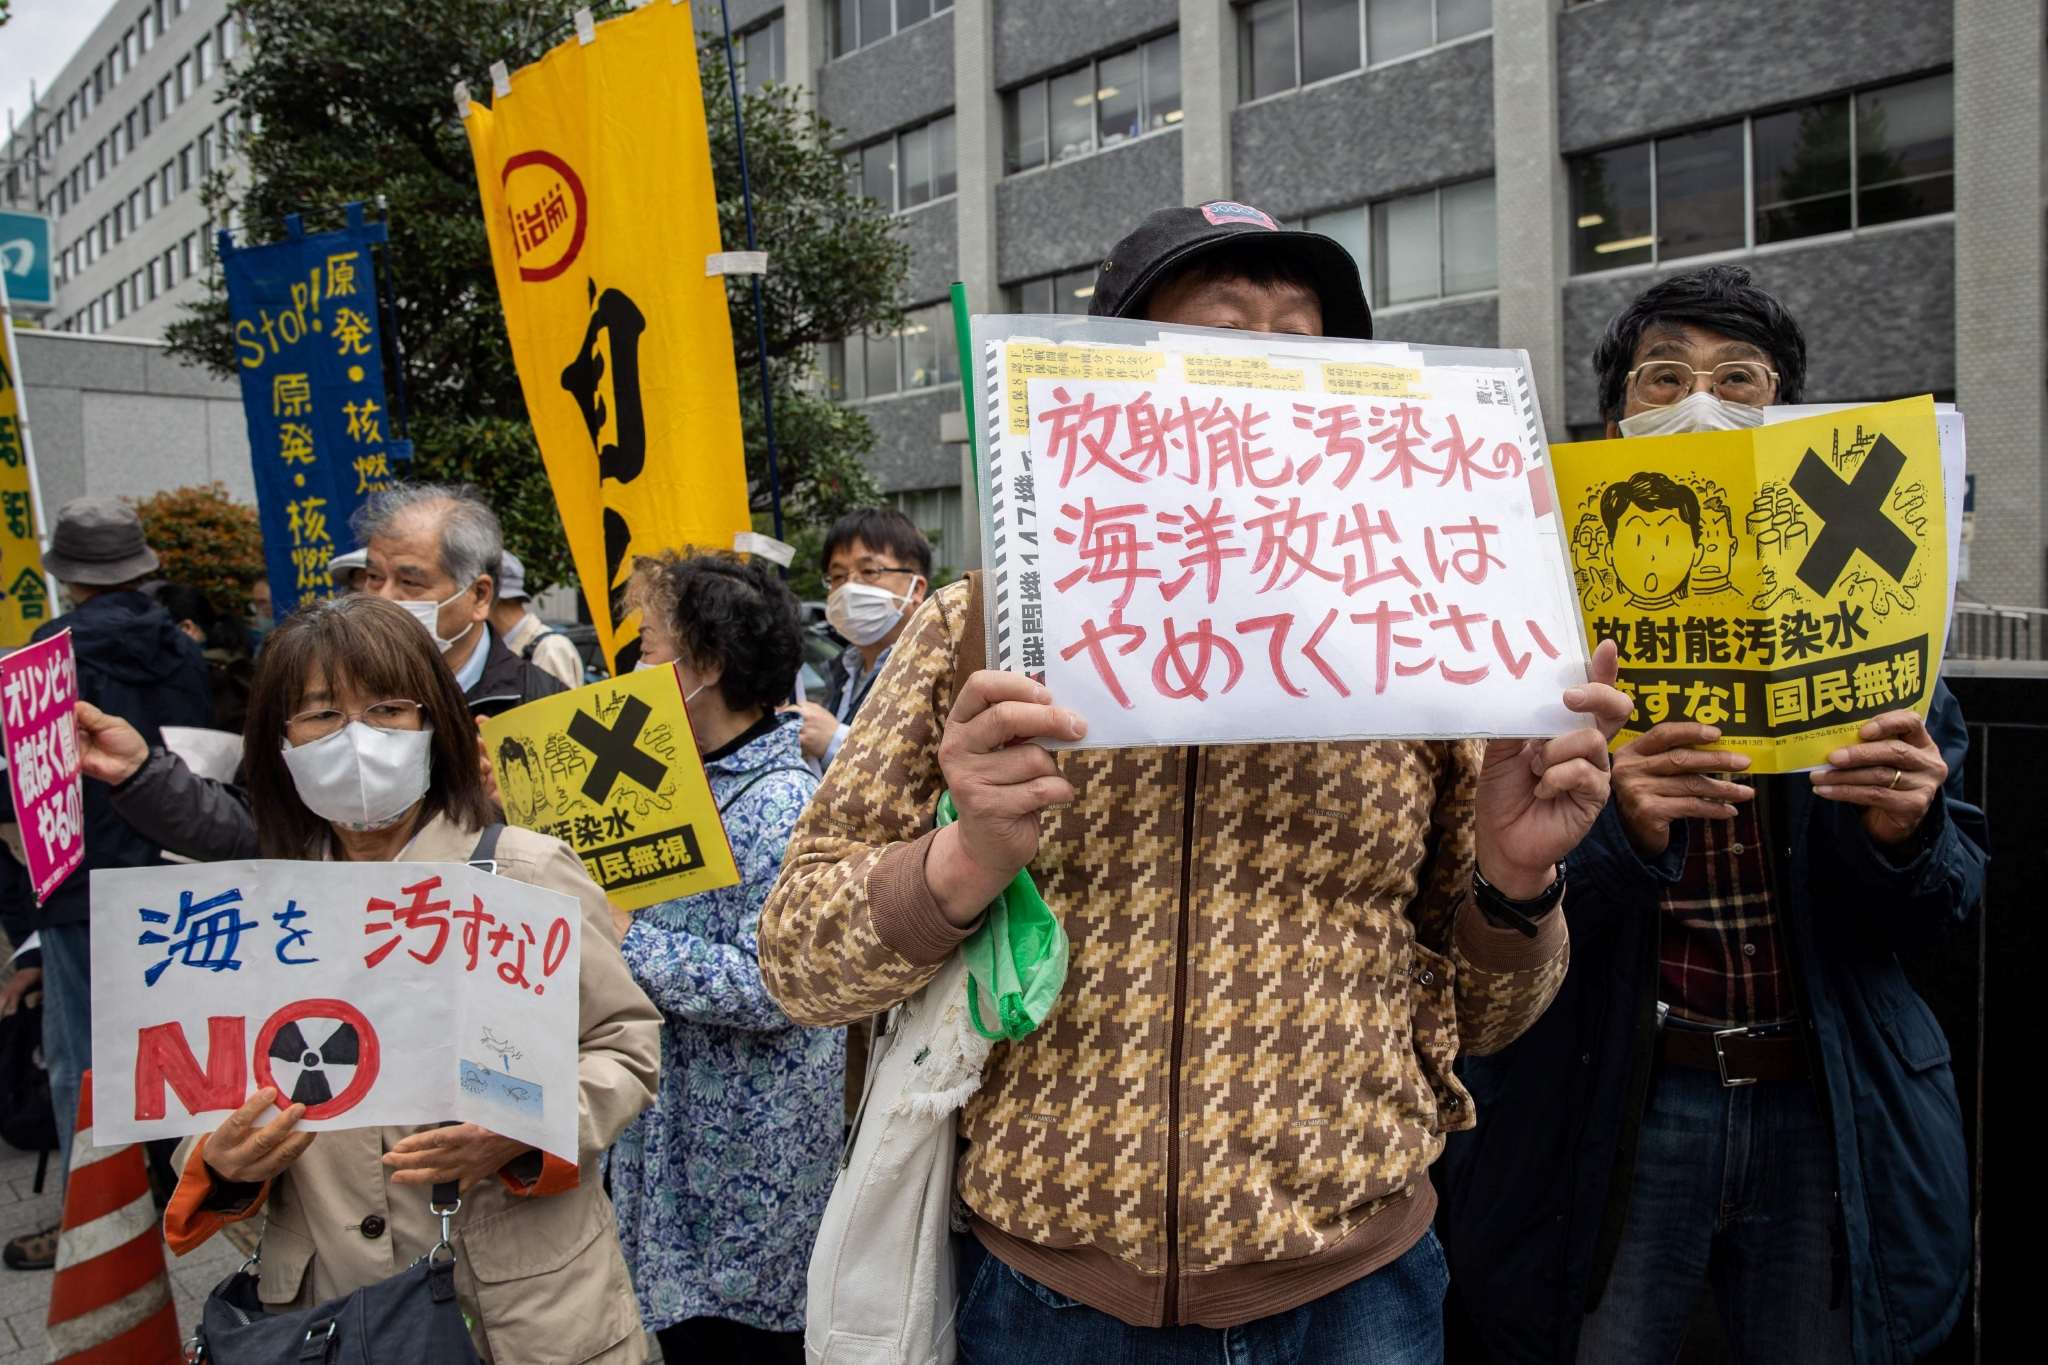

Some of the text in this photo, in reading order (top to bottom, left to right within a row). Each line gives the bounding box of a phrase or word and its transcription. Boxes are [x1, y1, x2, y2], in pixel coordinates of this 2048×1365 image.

[272, 373, 335, 606] 原発・核燃
[1038, 386, 1524, 492] 放射能汚染水の
[1053, 494, 1506, 609] 海洋放出は
[1060, 594, 1562, 710] やめてください
[1593, 601, 1869, 665] 放射能汚染水
[1765, 648, 1921, 728] 国民無視
[540, 806, 635, 848] 汚染水
[1307, 808, 1349, 820] HELLY HANSEN
[138, 875, 571, 995] 海を 汚すな!
[134, 998, 380, 1121] NO
[1291, 1118, 1329, 1128] HELLY HANSEN
